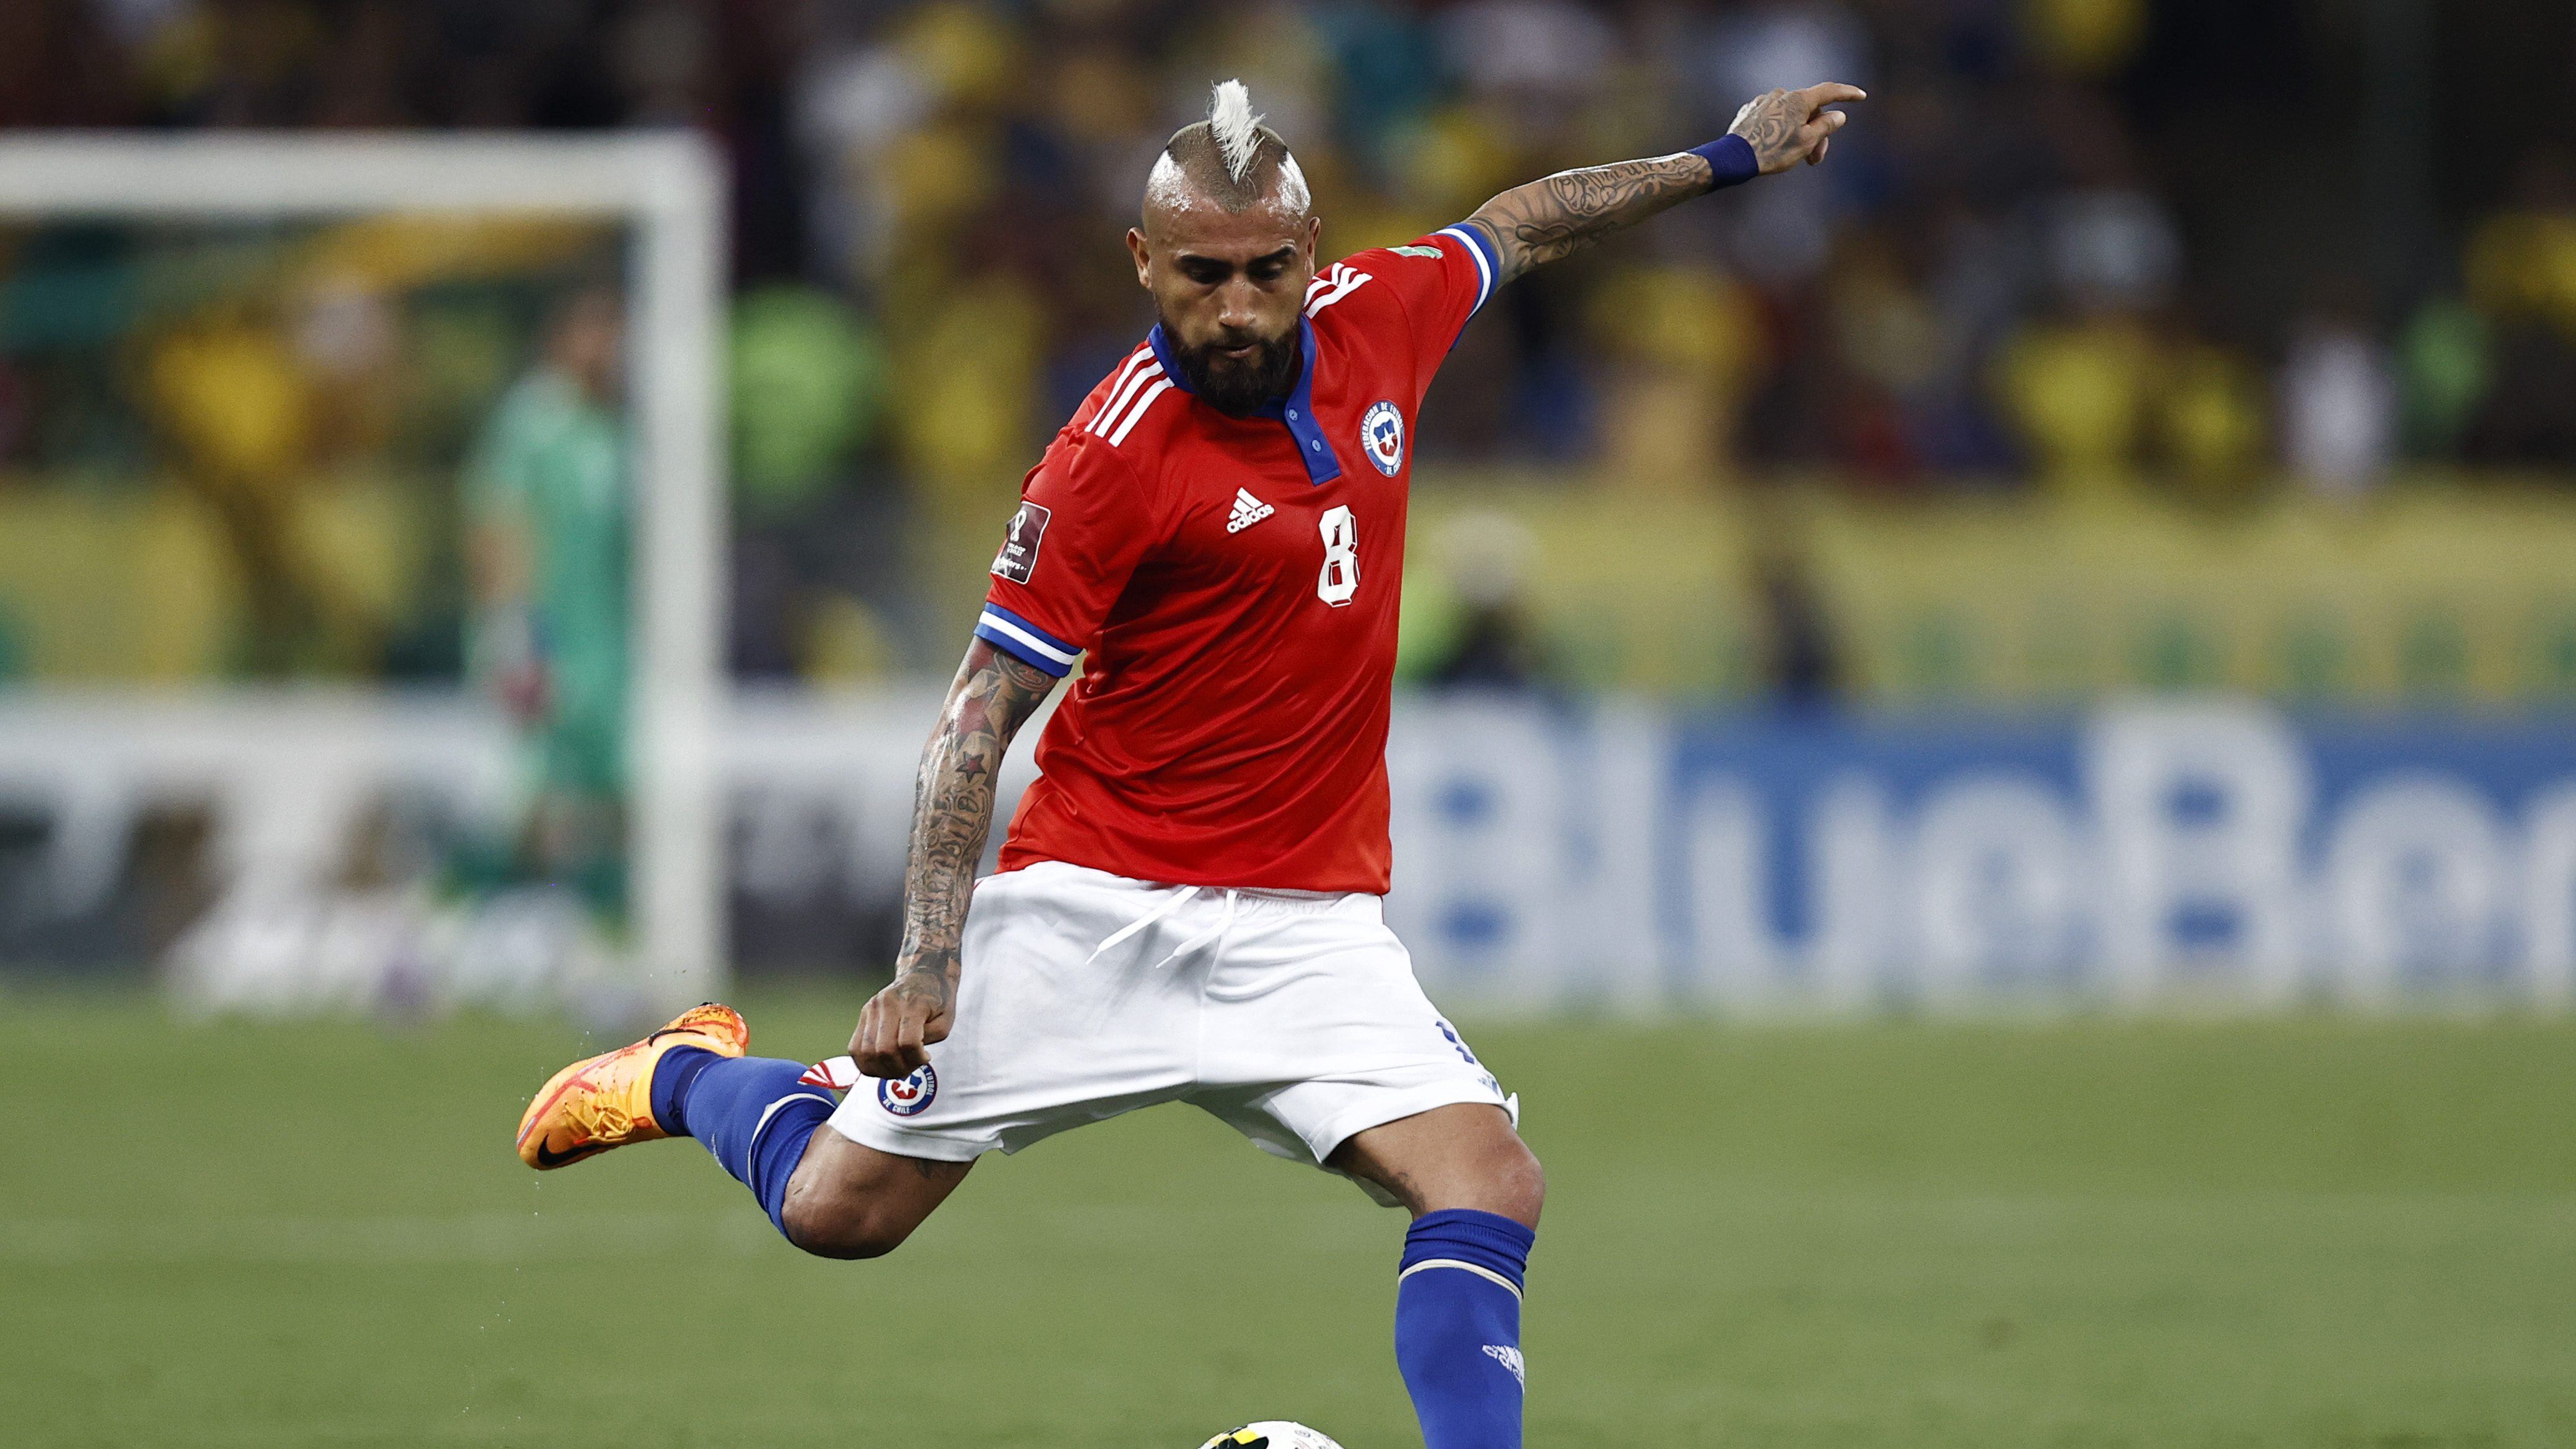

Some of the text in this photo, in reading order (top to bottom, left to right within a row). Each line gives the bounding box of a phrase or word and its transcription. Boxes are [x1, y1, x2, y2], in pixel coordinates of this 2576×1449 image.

[1381, 402, 1388, 411] DE
[1226, 503, 1275, 534] adidas
[1317, 504, 1361, 608] 8
[1385, 694, 2576, 1009] BlueBe
[882, 1098, 893, 1108] DE
